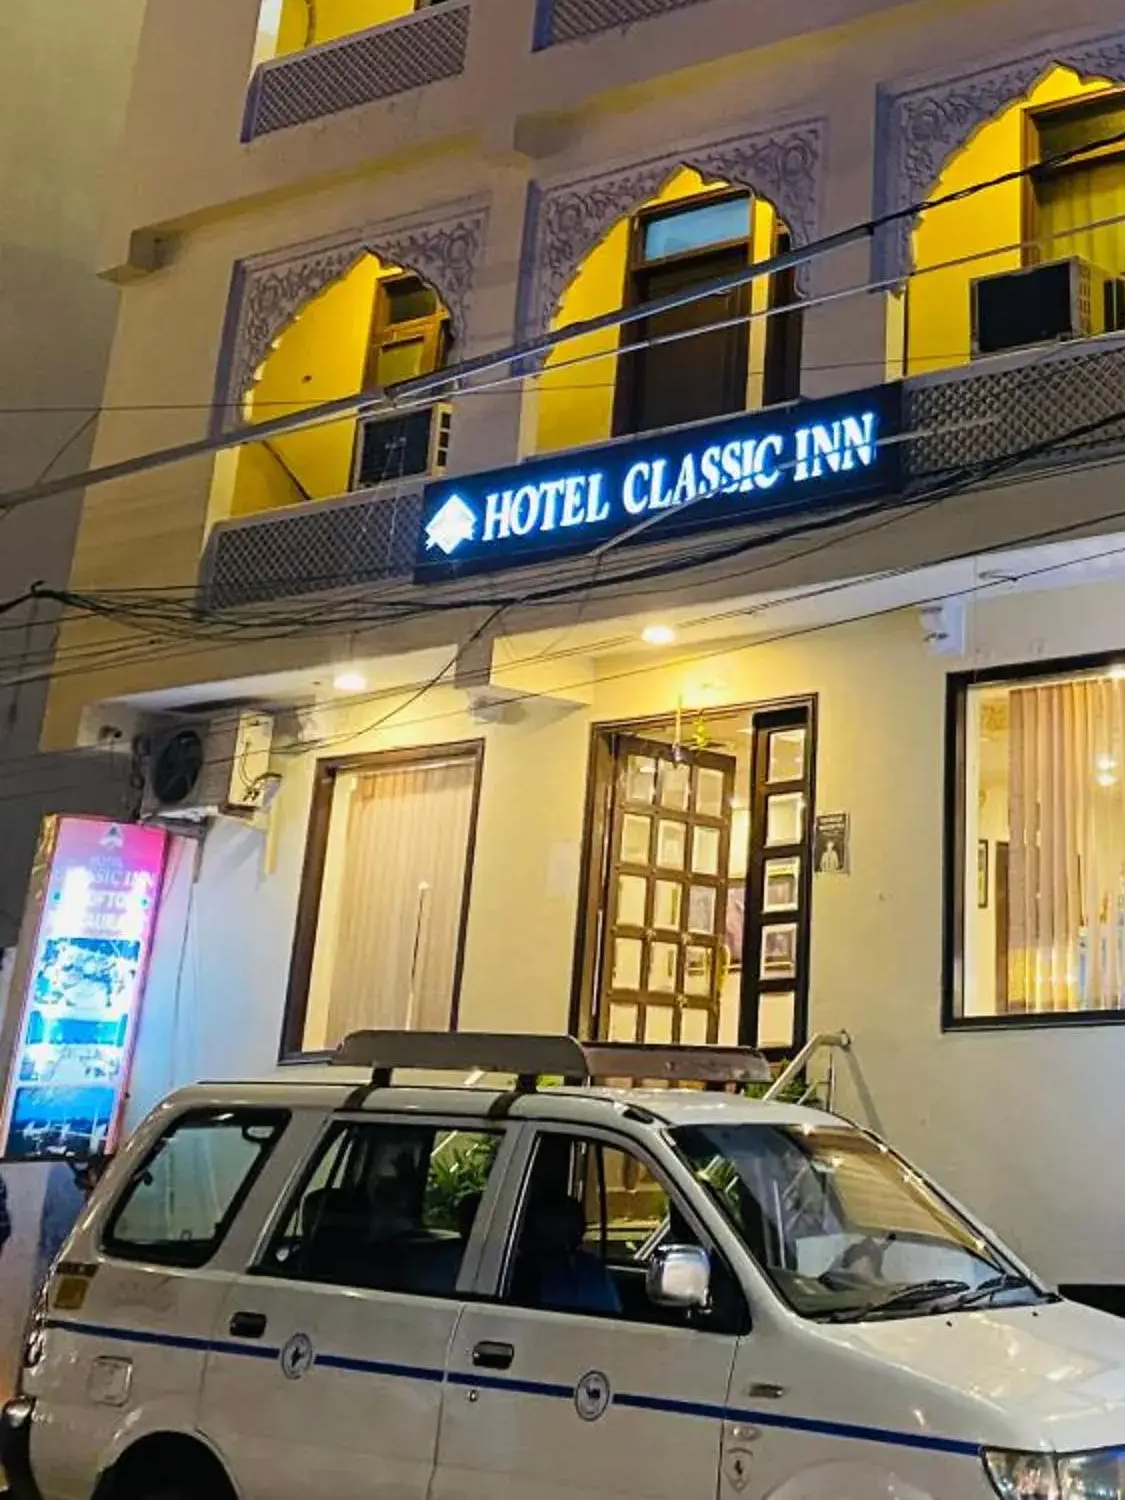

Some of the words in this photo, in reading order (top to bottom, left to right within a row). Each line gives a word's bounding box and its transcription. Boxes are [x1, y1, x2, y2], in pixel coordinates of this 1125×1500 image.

[482, 473, 610, 542] HOTEL
[622, 435, 783, 516] CLASSIC
[793, 412, 875, 482] INN
